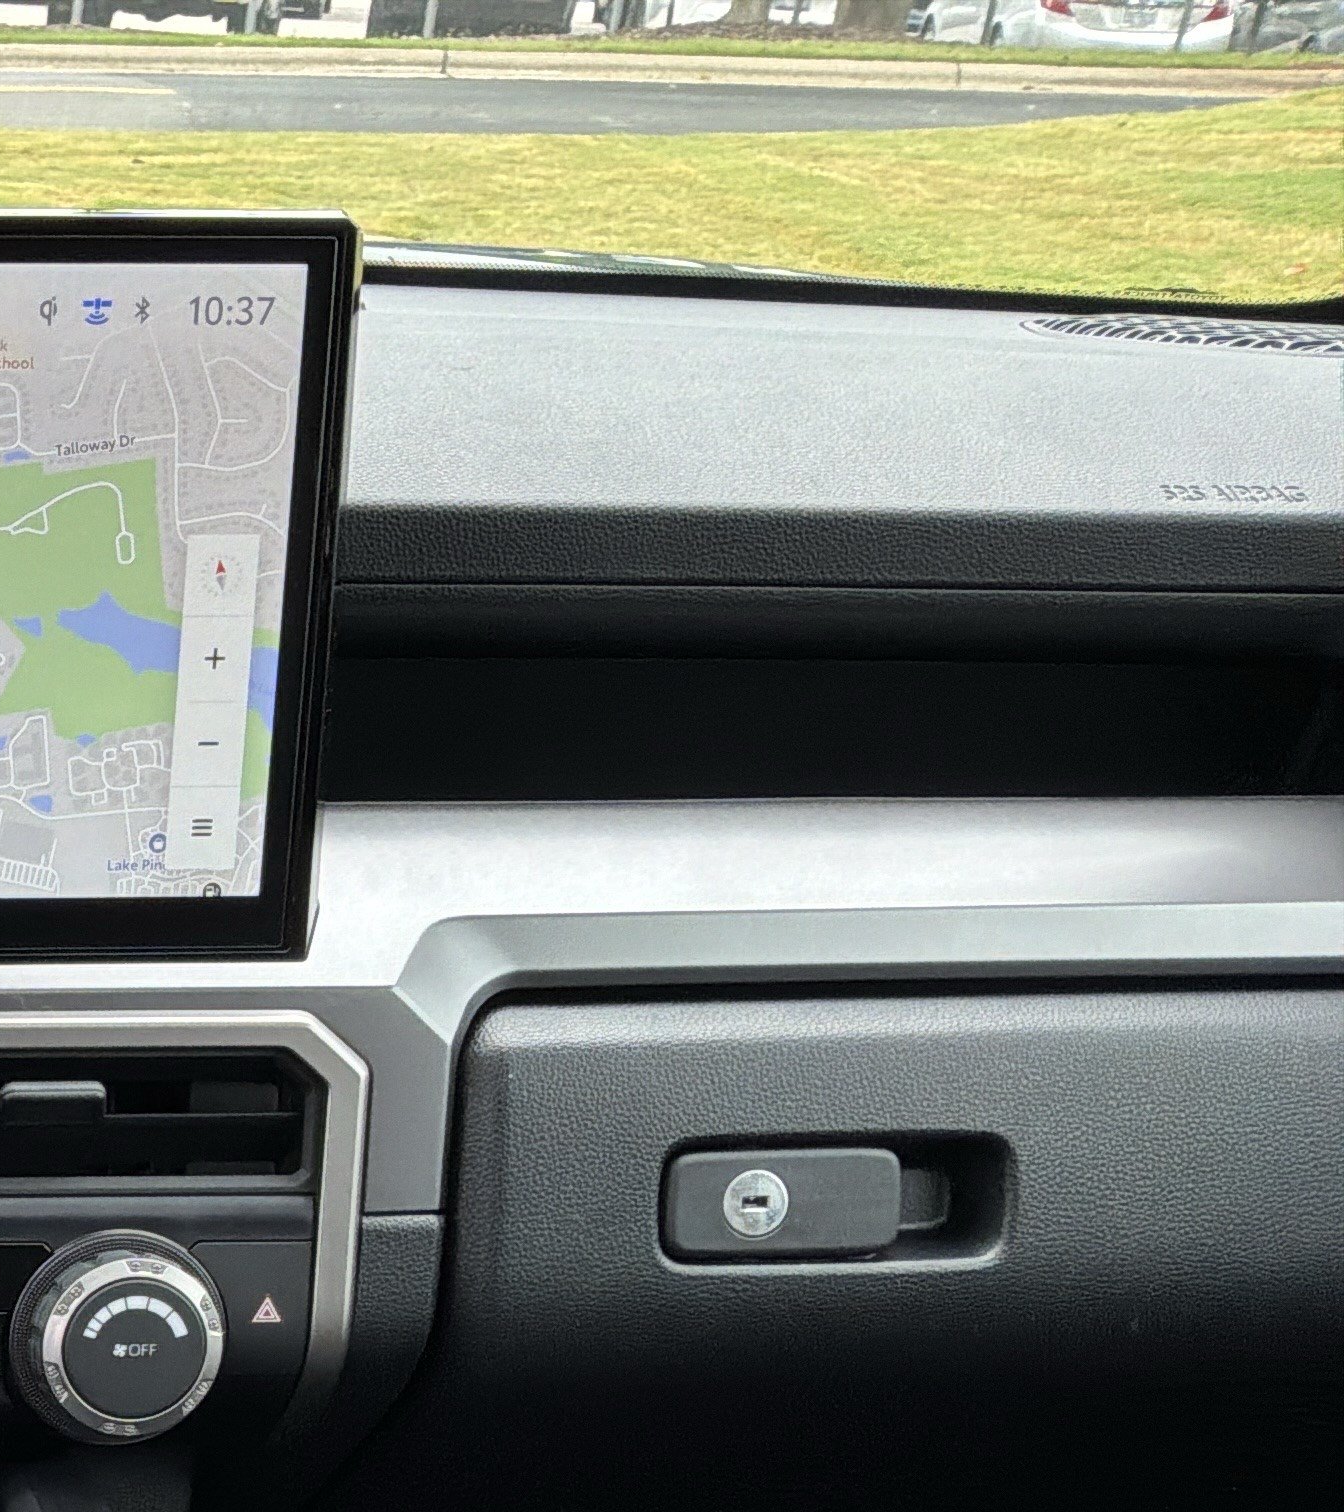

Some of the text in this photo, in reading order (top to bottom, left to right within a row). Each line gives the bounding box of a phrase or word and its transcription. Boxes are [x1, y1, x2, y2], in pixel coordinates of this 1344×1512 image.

[189, 296, 275, 326] 10:37
[55, 434, 136, 457] Talloway Dr
[107, 859, 138, 871] Lake
[128, 1344, 158, 1356] OFF
